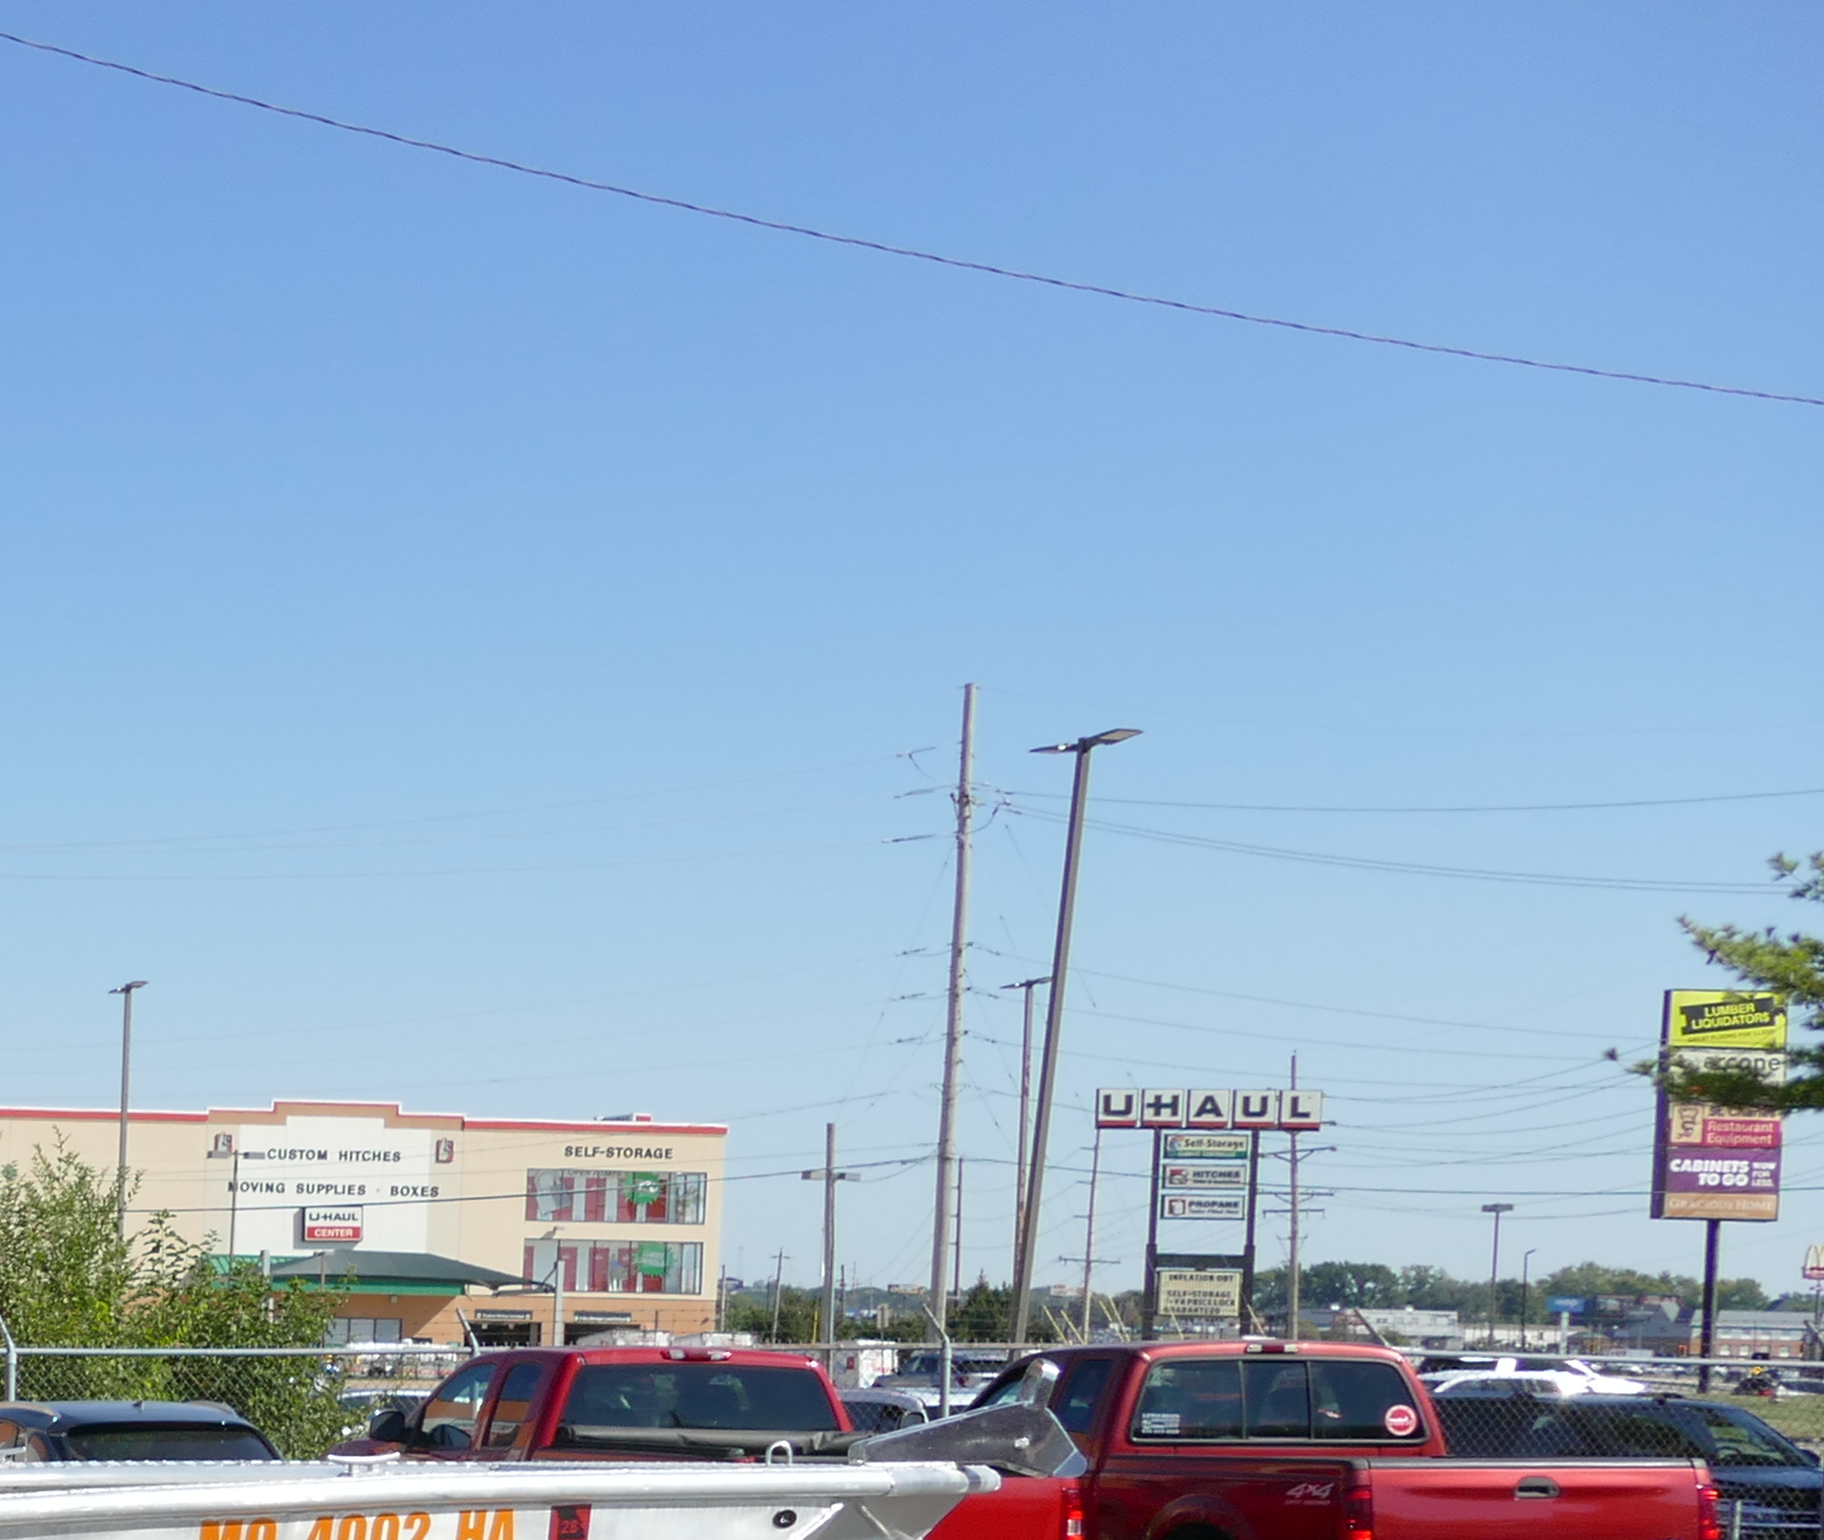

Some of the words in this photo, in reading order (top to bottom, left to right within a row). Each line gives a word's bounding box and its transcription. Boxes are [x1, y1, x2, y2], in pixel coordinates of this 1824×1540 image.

[1704, 1003, 1756, 1017] LUMBER
[1708, 1121, 1774, 1133] Restaurant
[1184, 1138, 1245, 1150] Self-Storage
[1707, 1132, 1773, 1146] Equipment
[267, 1149, 328, 1160] CUSTOM
[339, 1151, 401, 1162] HITCHES
[564, 1146, 673, 1160] SELF-STORAGE
[1670, 1159, 1749, 1173] CABINETS
[1698, 1173, 1720, 1186] TO
[1722, 1174, 1749, 1187] GO
[296, 1183, 366, 1195] SUPPLIES
[390, 1186, 440, 1197] BOXES
[314, 1228, 353, 1237] CENTER
